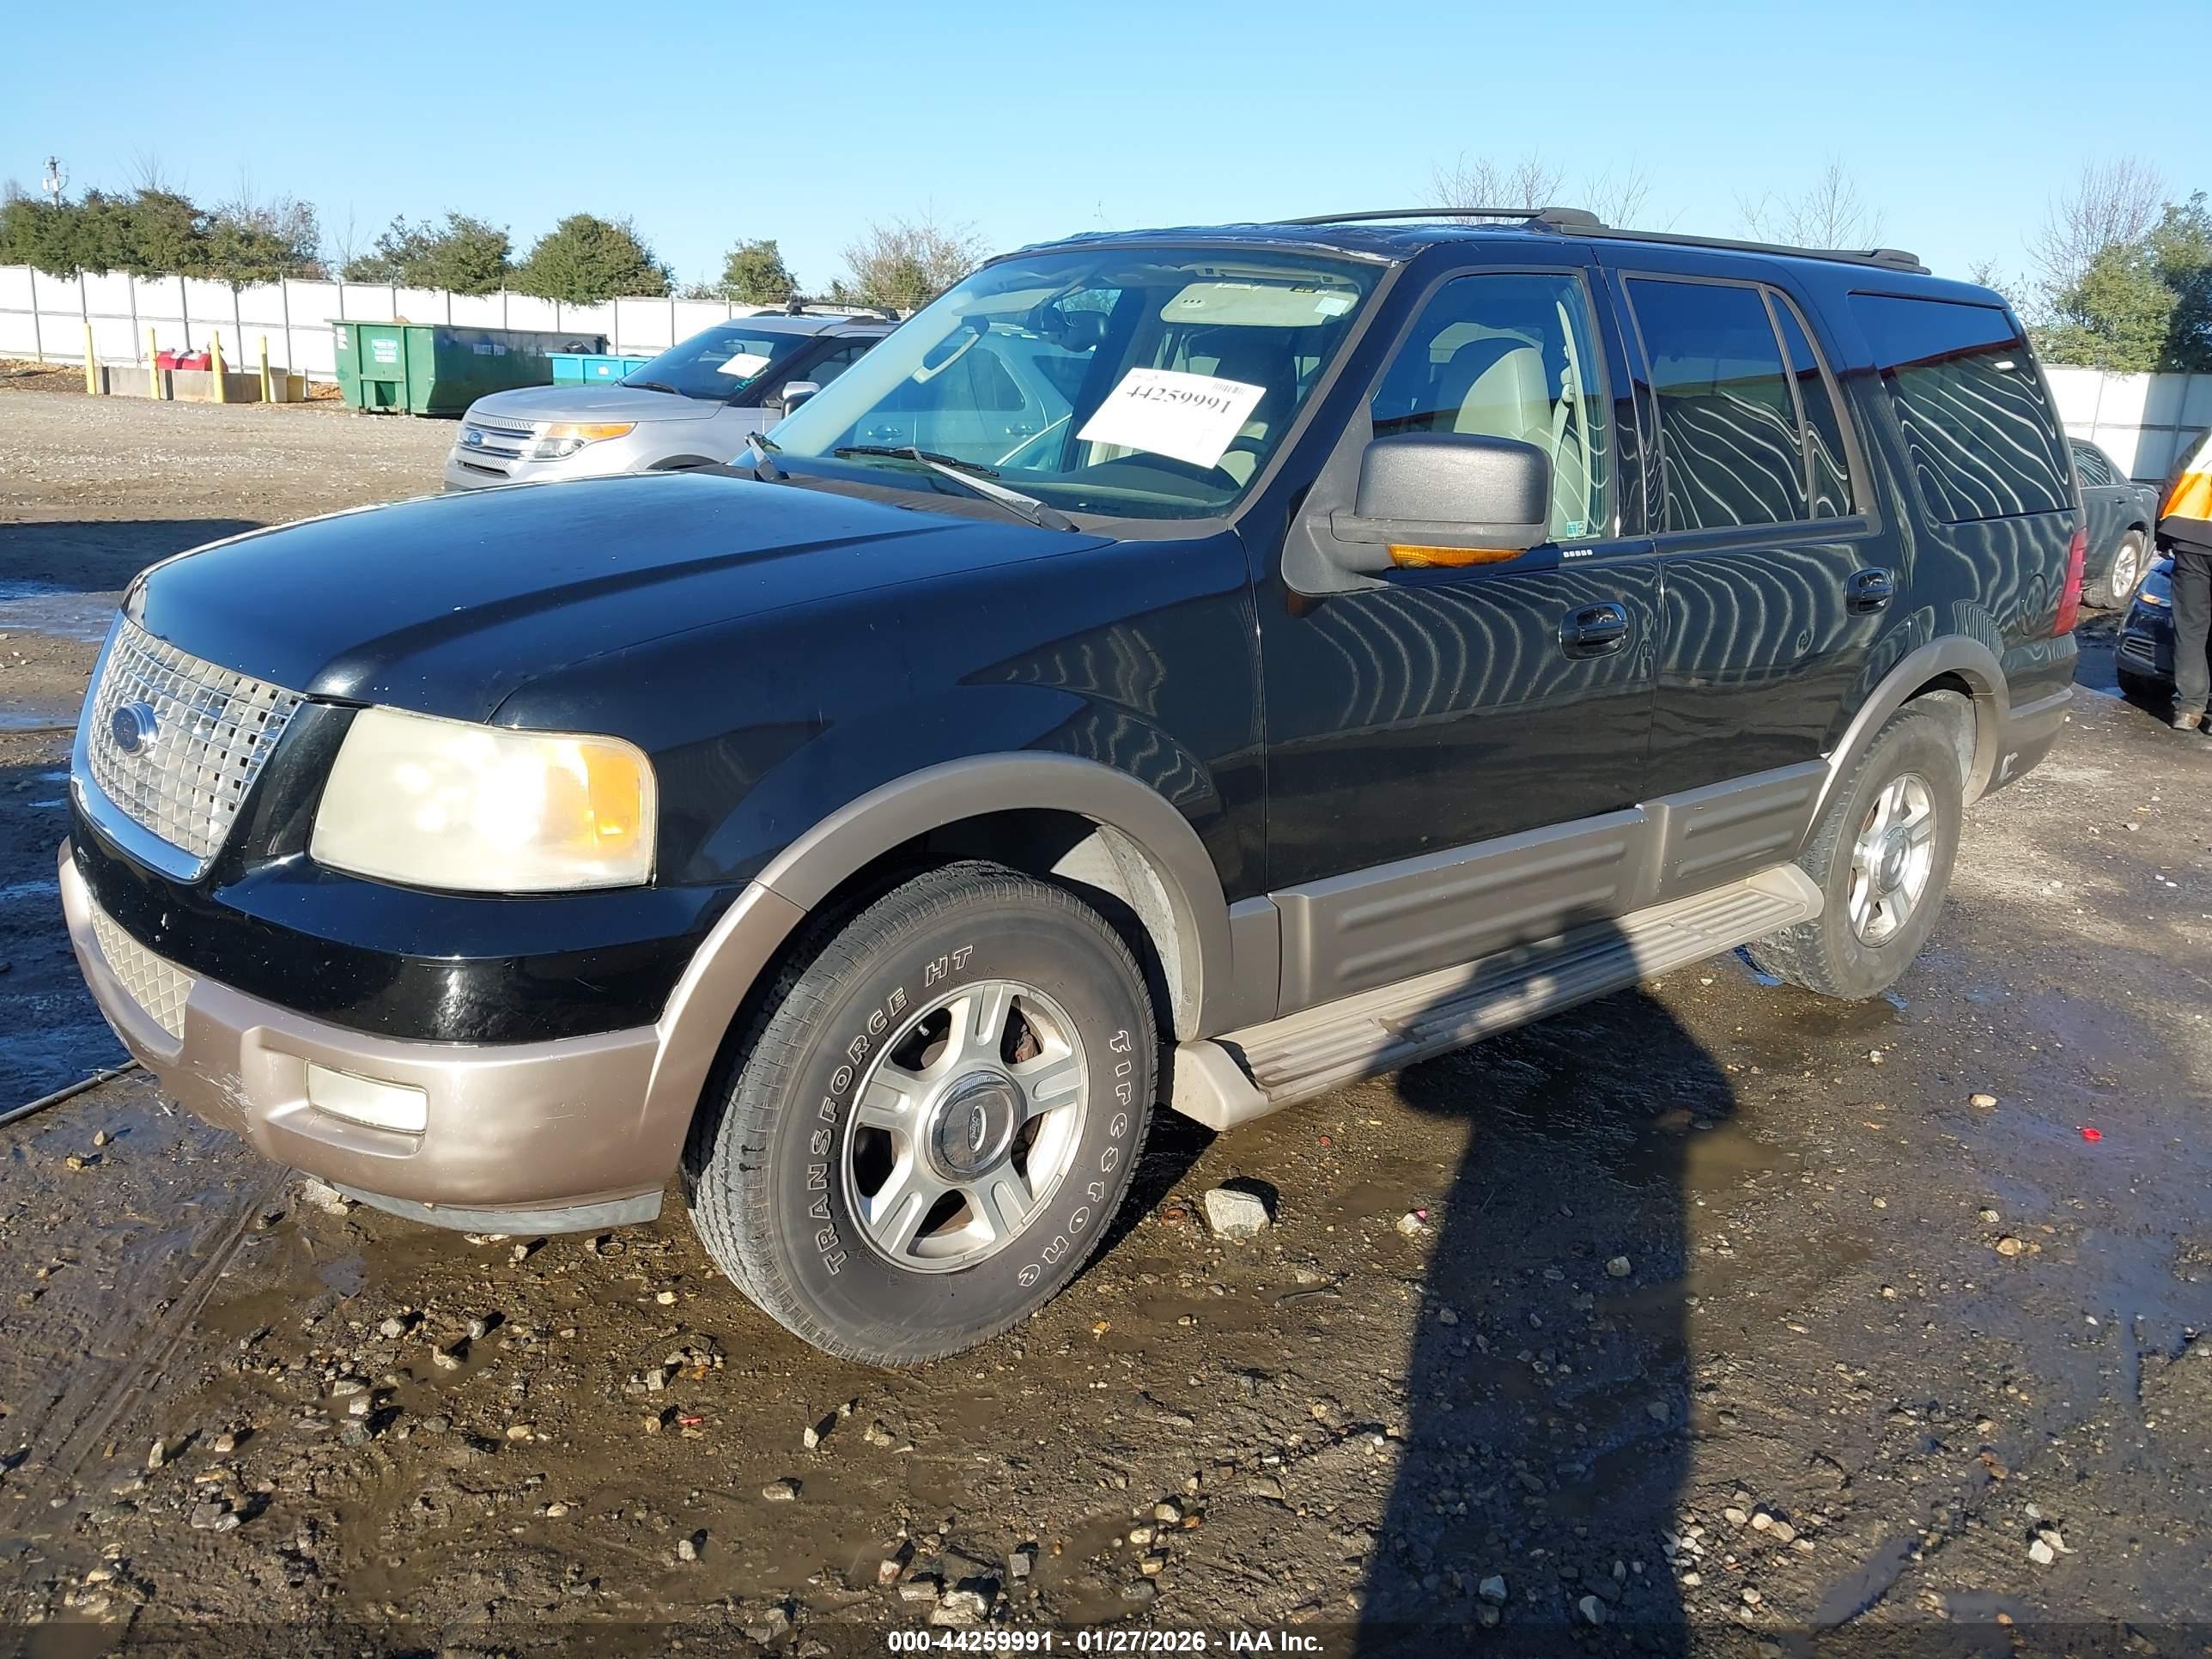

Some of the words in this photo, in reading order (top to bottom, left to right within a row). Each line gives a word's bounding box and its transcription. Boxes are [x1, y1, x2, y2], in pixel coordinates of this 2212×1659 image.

[1126, 385, 1232, 414] 44259991
[806, 987, 908, 1277] TRANSFORCE
[925, 944, 975, 988] HT
